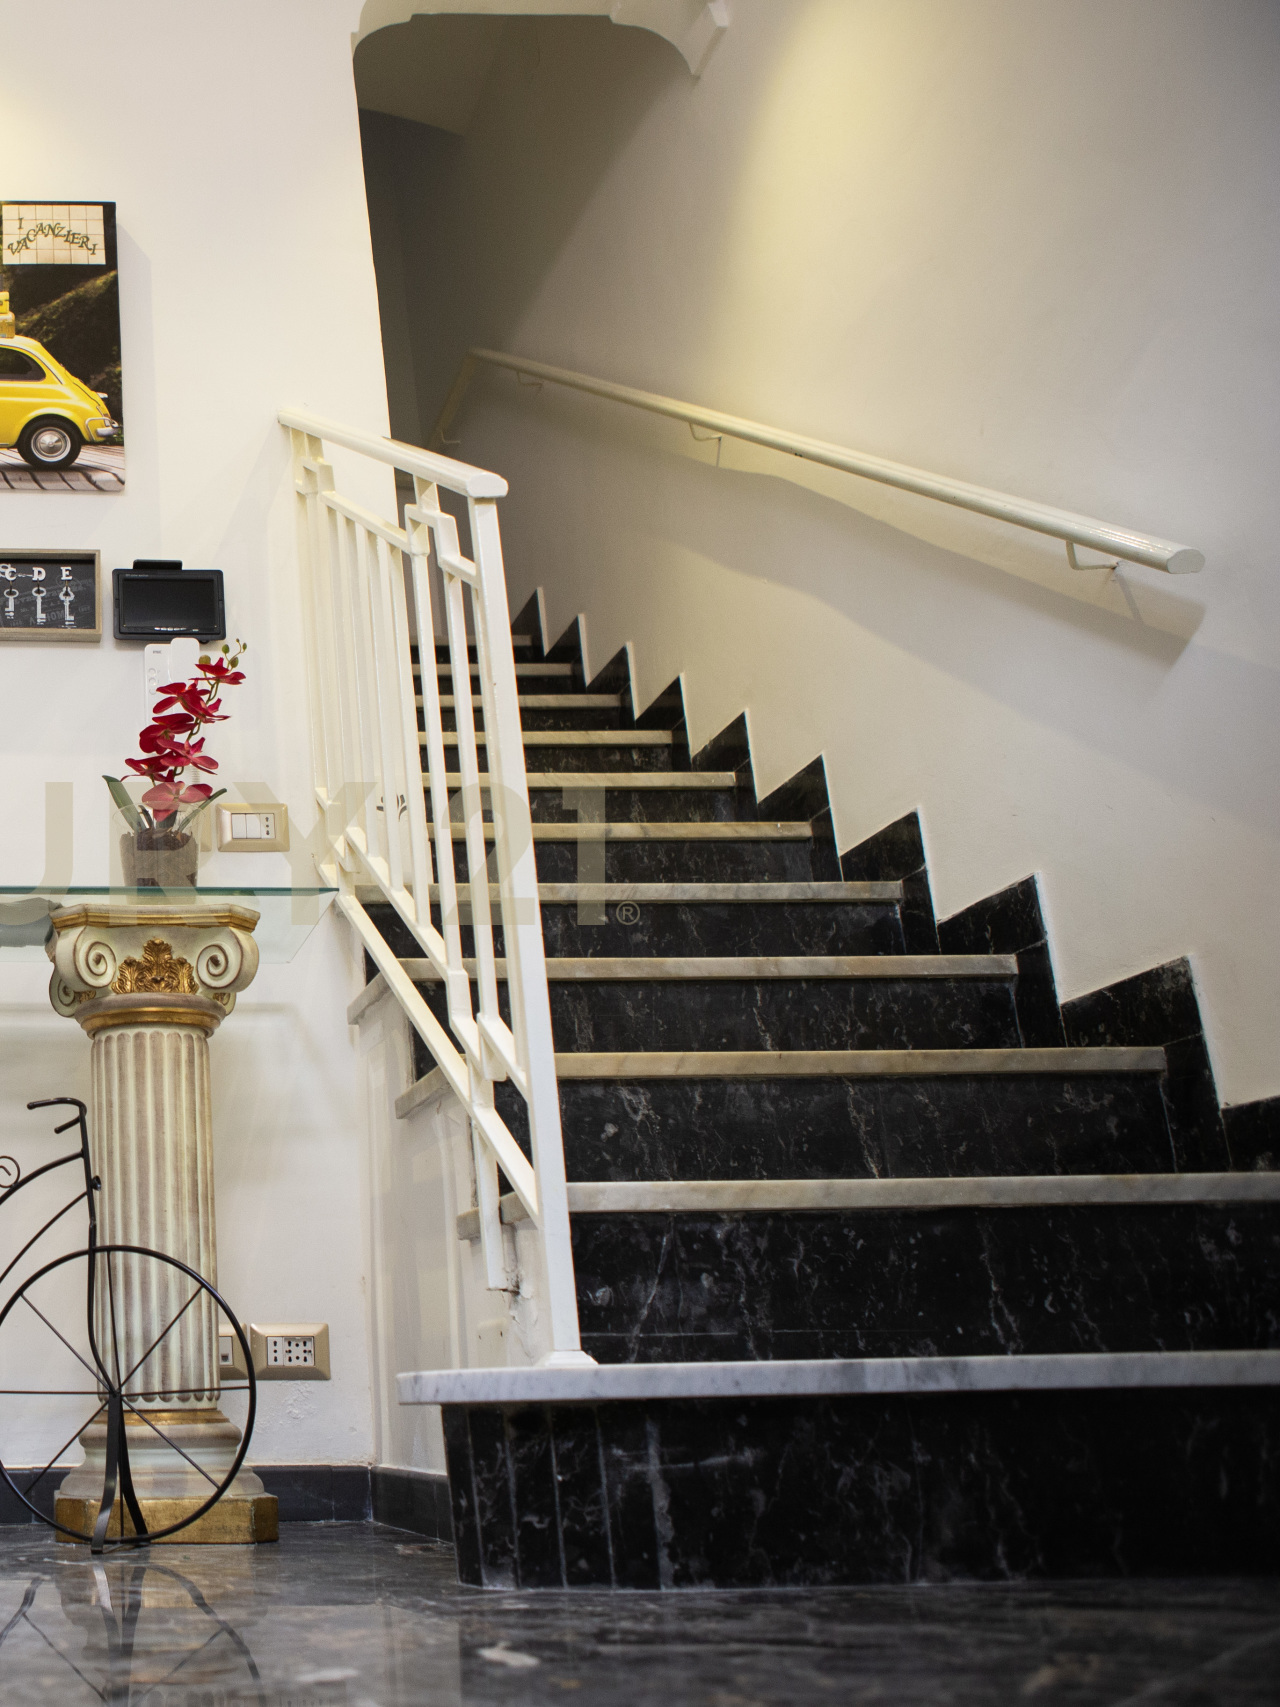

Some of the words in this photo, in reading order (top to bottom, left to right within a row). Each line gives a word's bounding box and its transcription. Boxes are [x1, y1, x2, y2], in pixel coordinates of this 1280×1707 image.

[18, 217, 24, 230] I
[7, 222, 98, 256] VACANZIERI
[5, 567, 17, 581] C
[32, 566, 46, 581] D
[60, 566, 73, 580] E
